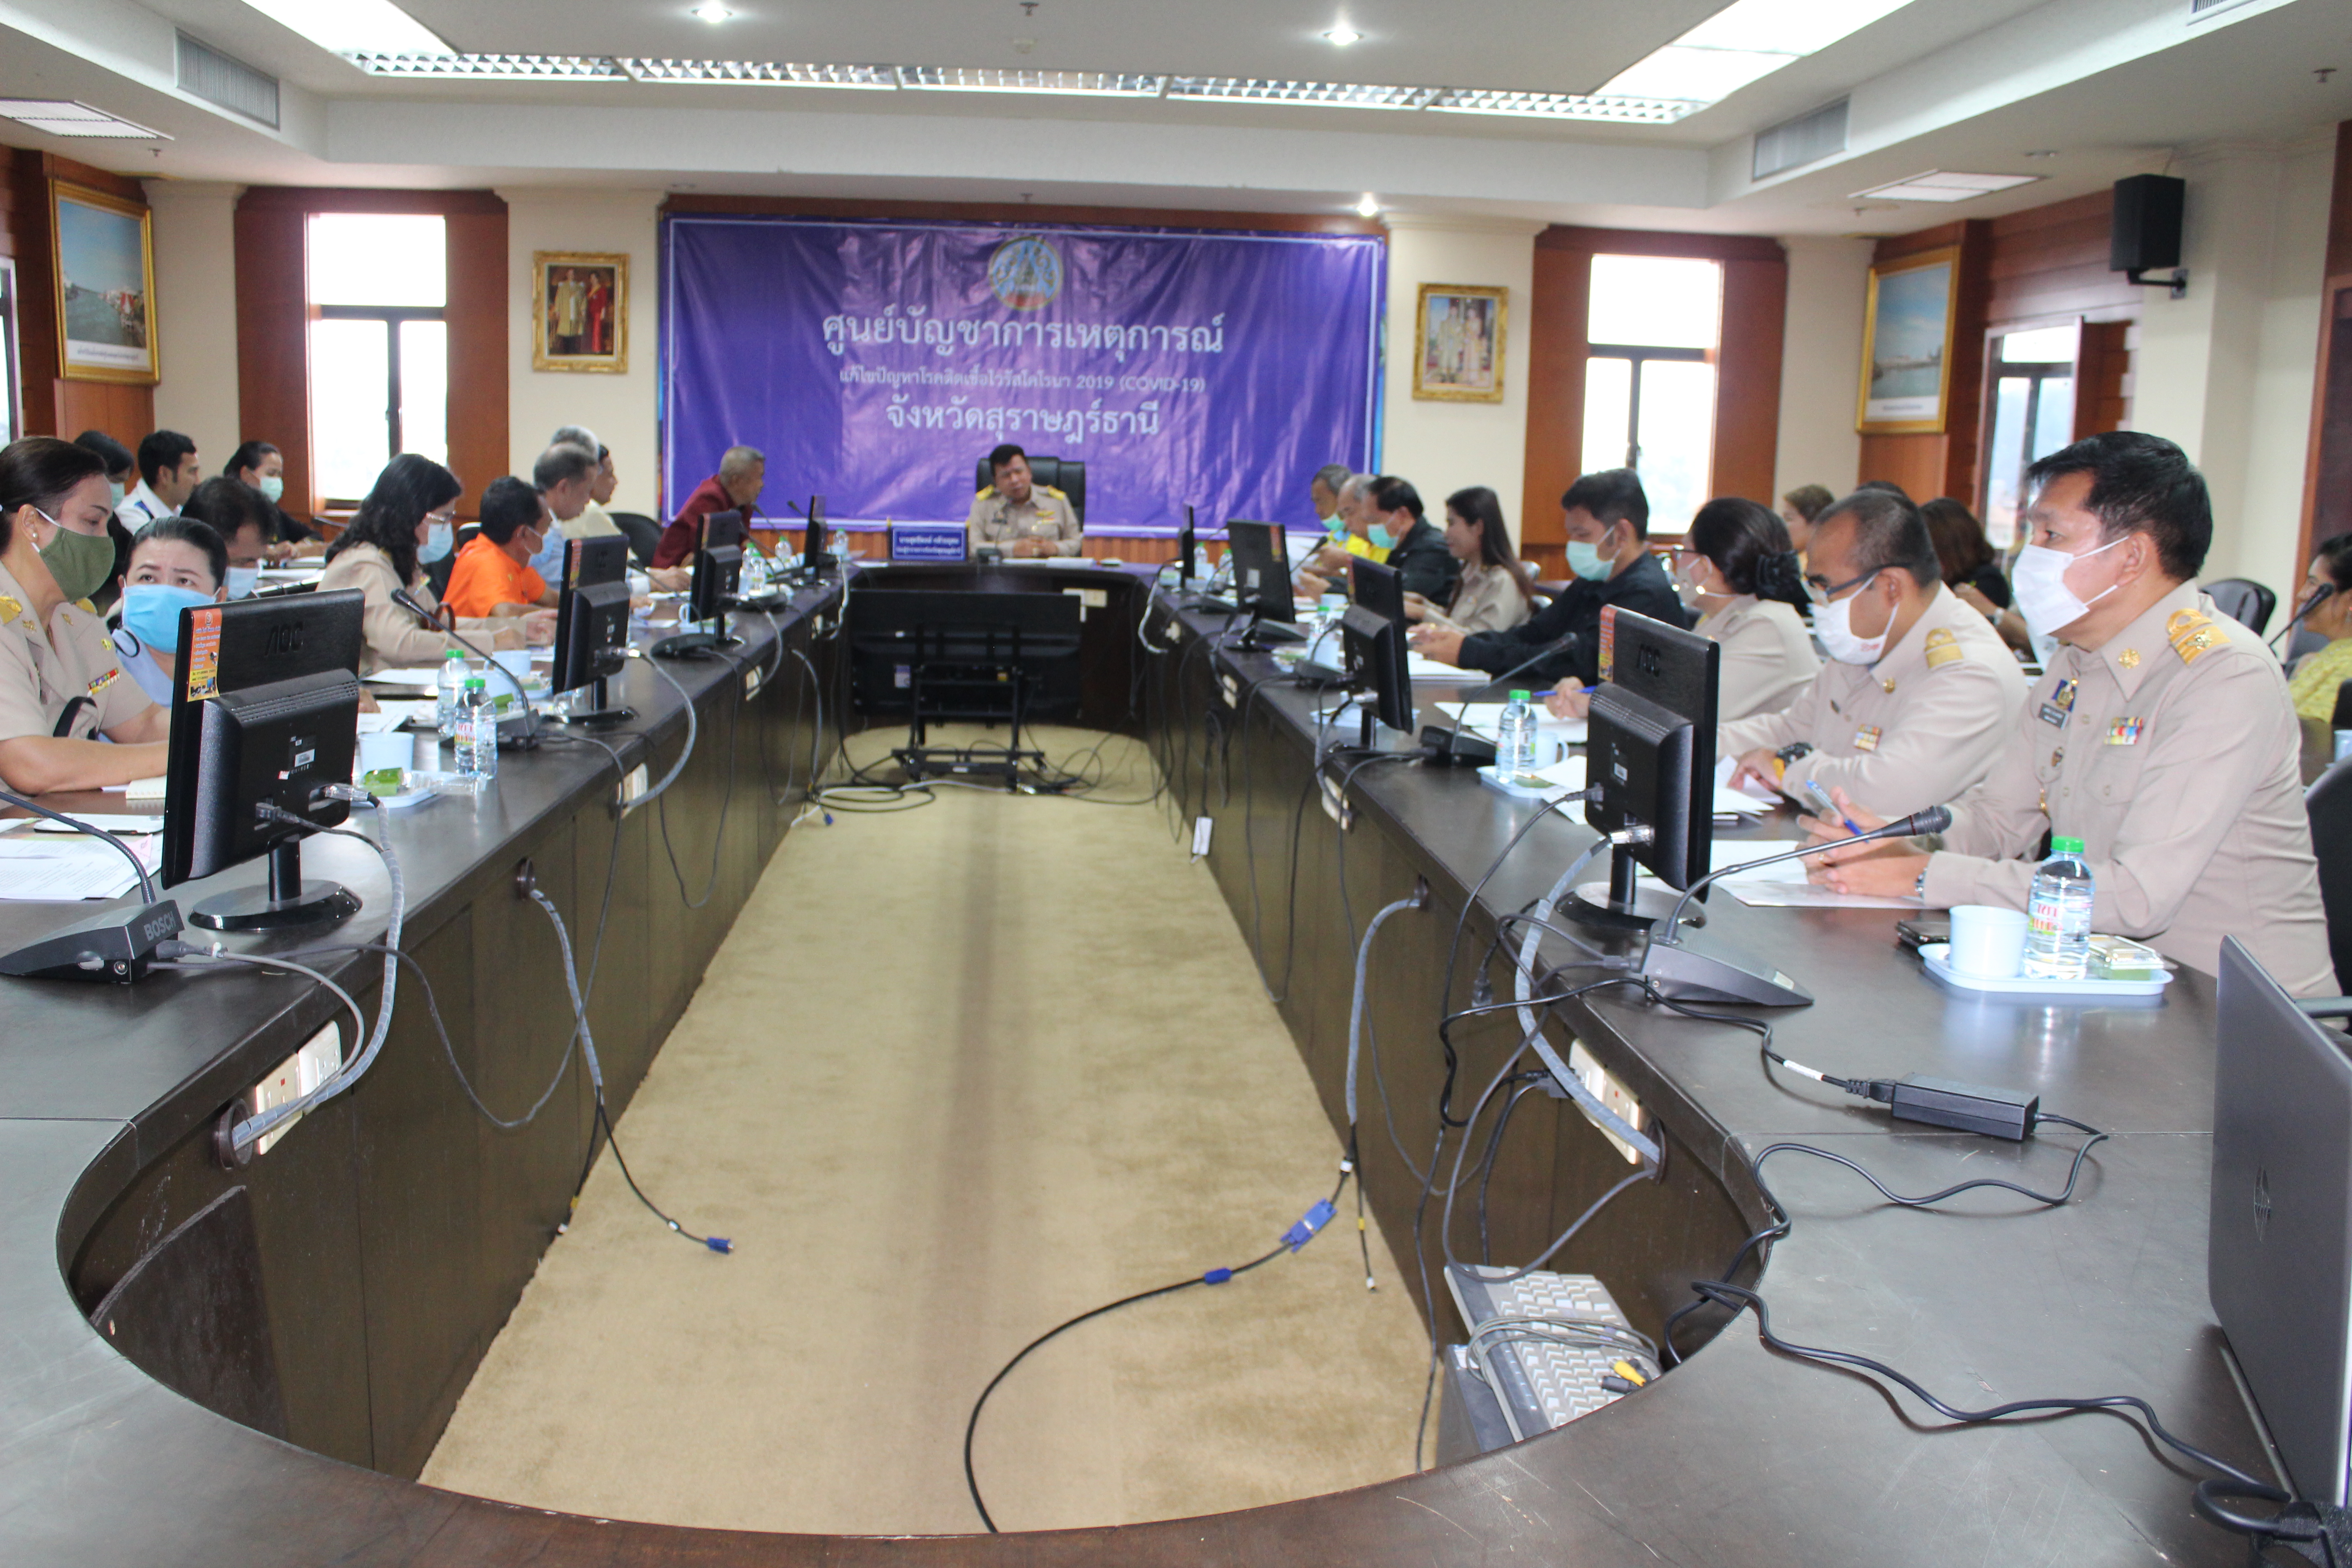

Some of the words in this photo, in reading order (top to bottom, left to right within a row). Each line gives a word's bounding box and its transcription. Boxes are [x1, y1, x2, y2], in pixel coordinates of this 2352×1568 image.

[823, 304, 1225, 362] ศูนย์บัญชาการเหตุการณ์
[839, 363, 1071, 389] แก้ไขปัญหาโรคติดเชื้อไวรัสโคโรนา
[1076, 374, 1115, 391] 2019
[1119, 374, 1207, 393] (COVID-19)
[886, 393, 1160, 443] จังหวัดสุราษฎร์ธานี
[143, 911, 176, 941] BOSCH
